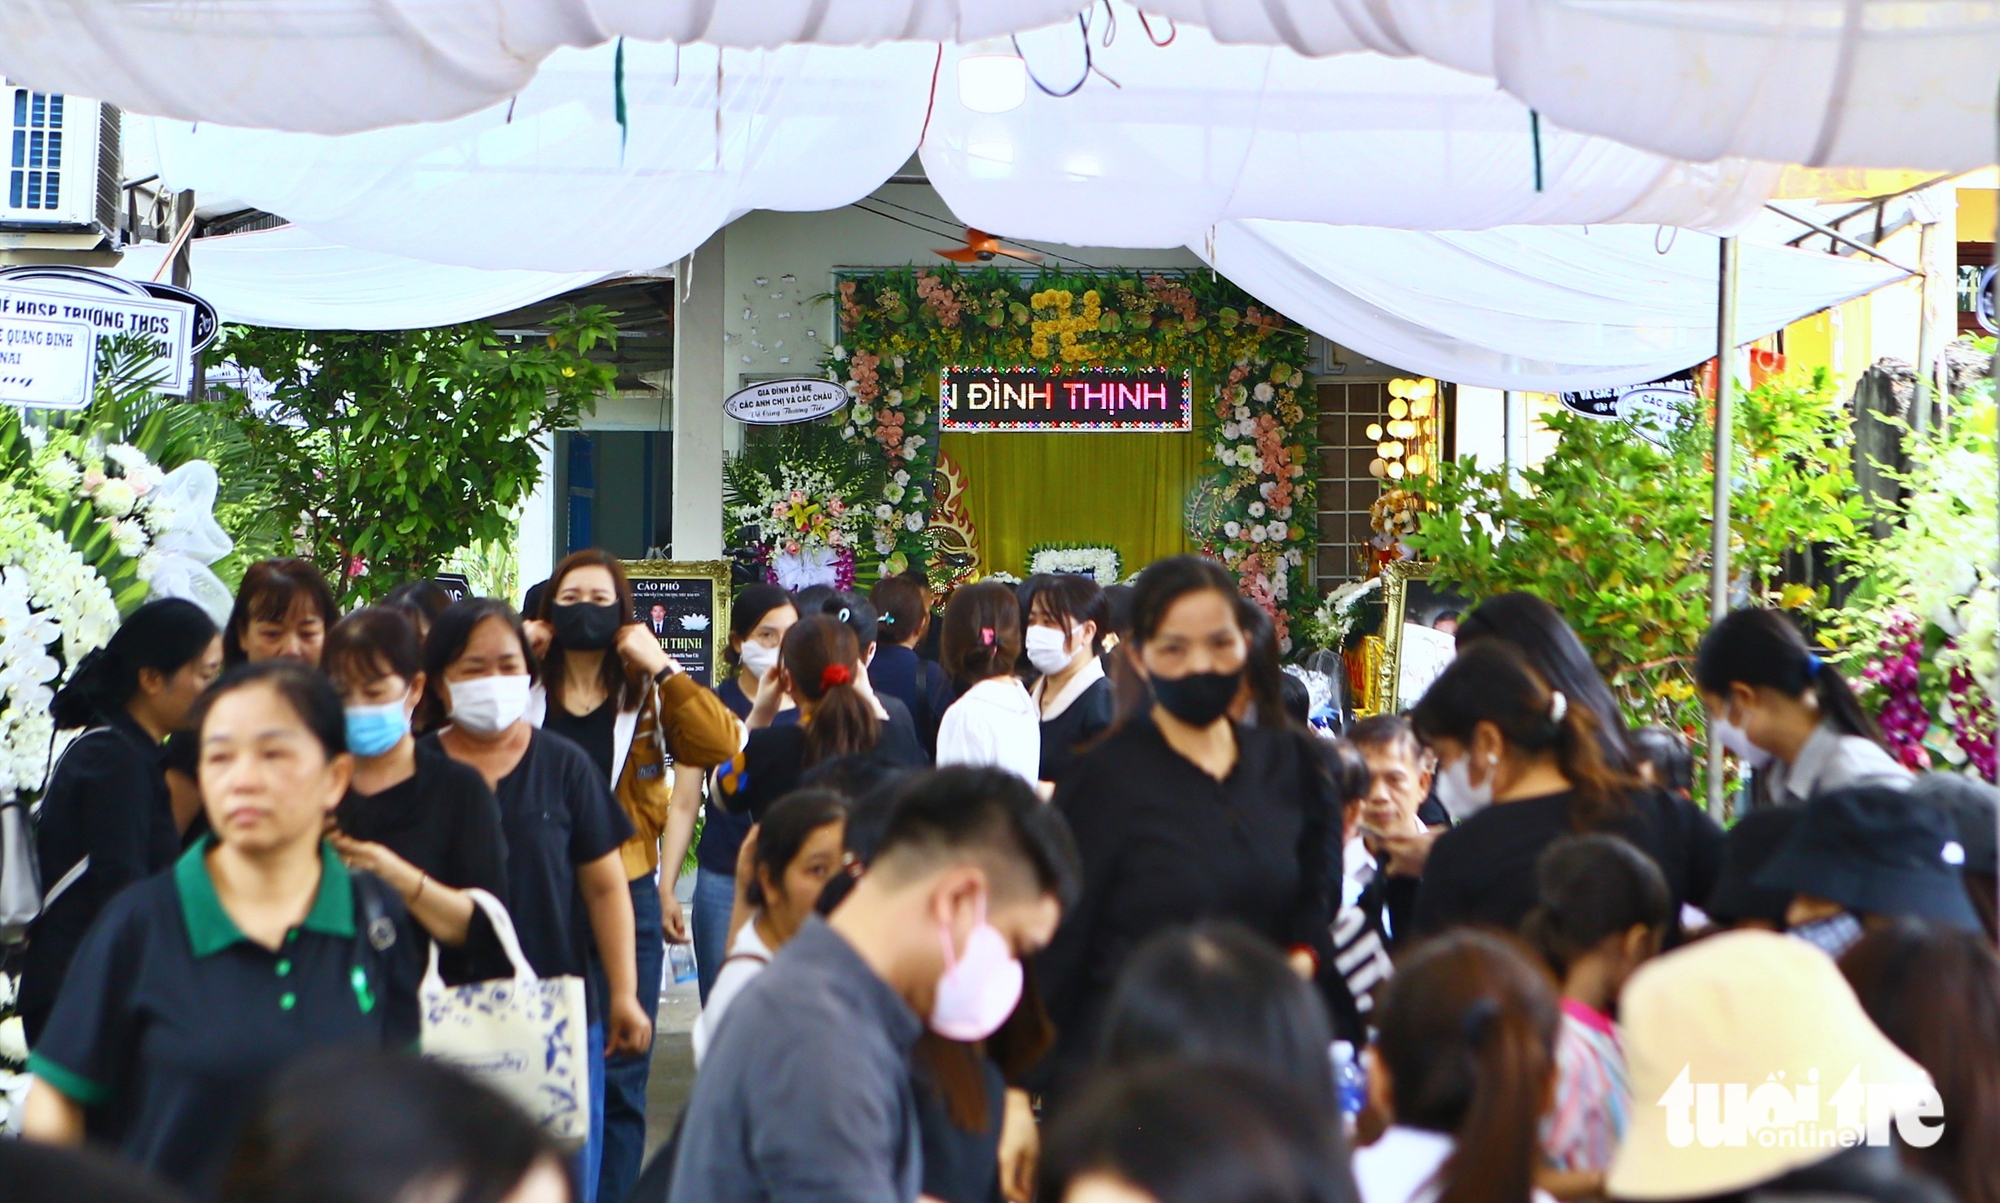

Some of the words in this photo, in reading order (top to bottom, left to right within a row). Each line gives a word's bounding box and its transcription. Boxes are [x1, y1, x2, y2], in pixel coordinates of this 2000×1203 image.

[130, 313, 169, 335] THCS
[772, 386, 789, 394] ĐÌNH
[791, 383, 801, 392] BỐ
[967, 376, 1052, 410] ĐÌNH
[1063, 382, 1167, 416] THỊNH
[740, 400, 754, 409] CÁC
[756, 399, 771, 407] ANH
[772, 398, 785, 406] CHỊ
[787, 394, 796, 404] VÀ
[798, 394, 812, 402] CÁC
[813, 392, 832, 400] CHÁU
[637, 581, 658, 591] CÁO
[660, 581, 680, 591] PHÓ
[670, 638, 702, 651] THỊNH
